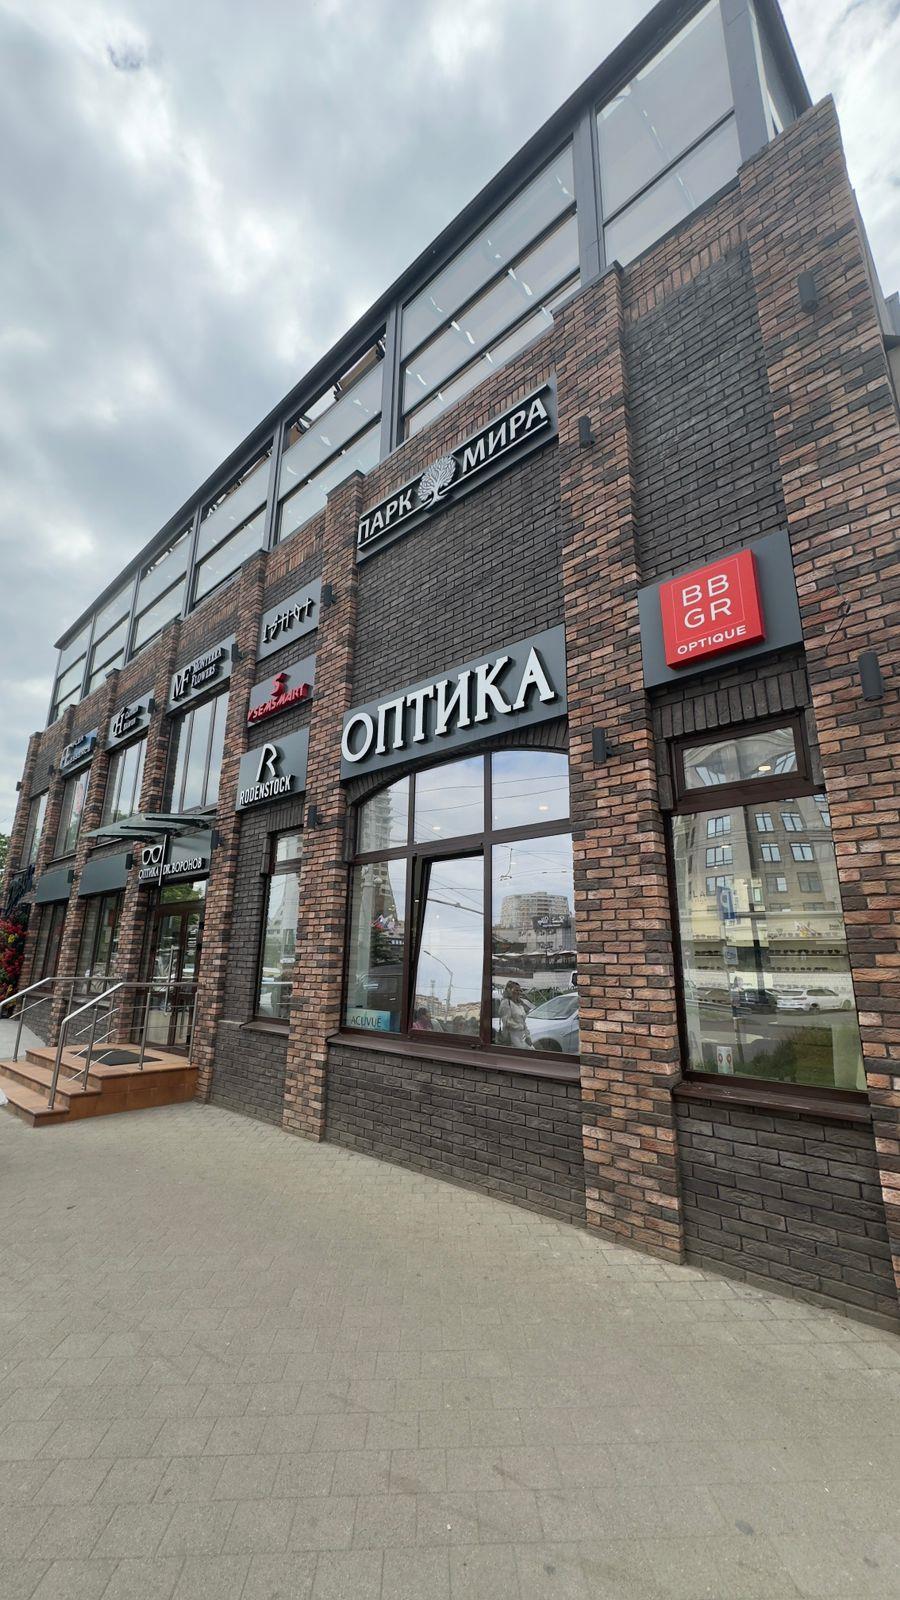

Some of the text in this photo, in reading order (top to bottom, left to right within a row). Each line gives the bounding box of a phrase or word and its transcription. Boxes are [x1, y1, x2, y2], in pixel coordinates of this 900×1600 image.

[357, 397, 548, 544] ПАРК МИРА
[677, 624, 747, 655] OPTIQUE
[341, 646, 555, 763] ОПТИКА
[238, 774, 292, 806] RODENSTOCK
[351, 1015, 382, 1028] ACUVUE
